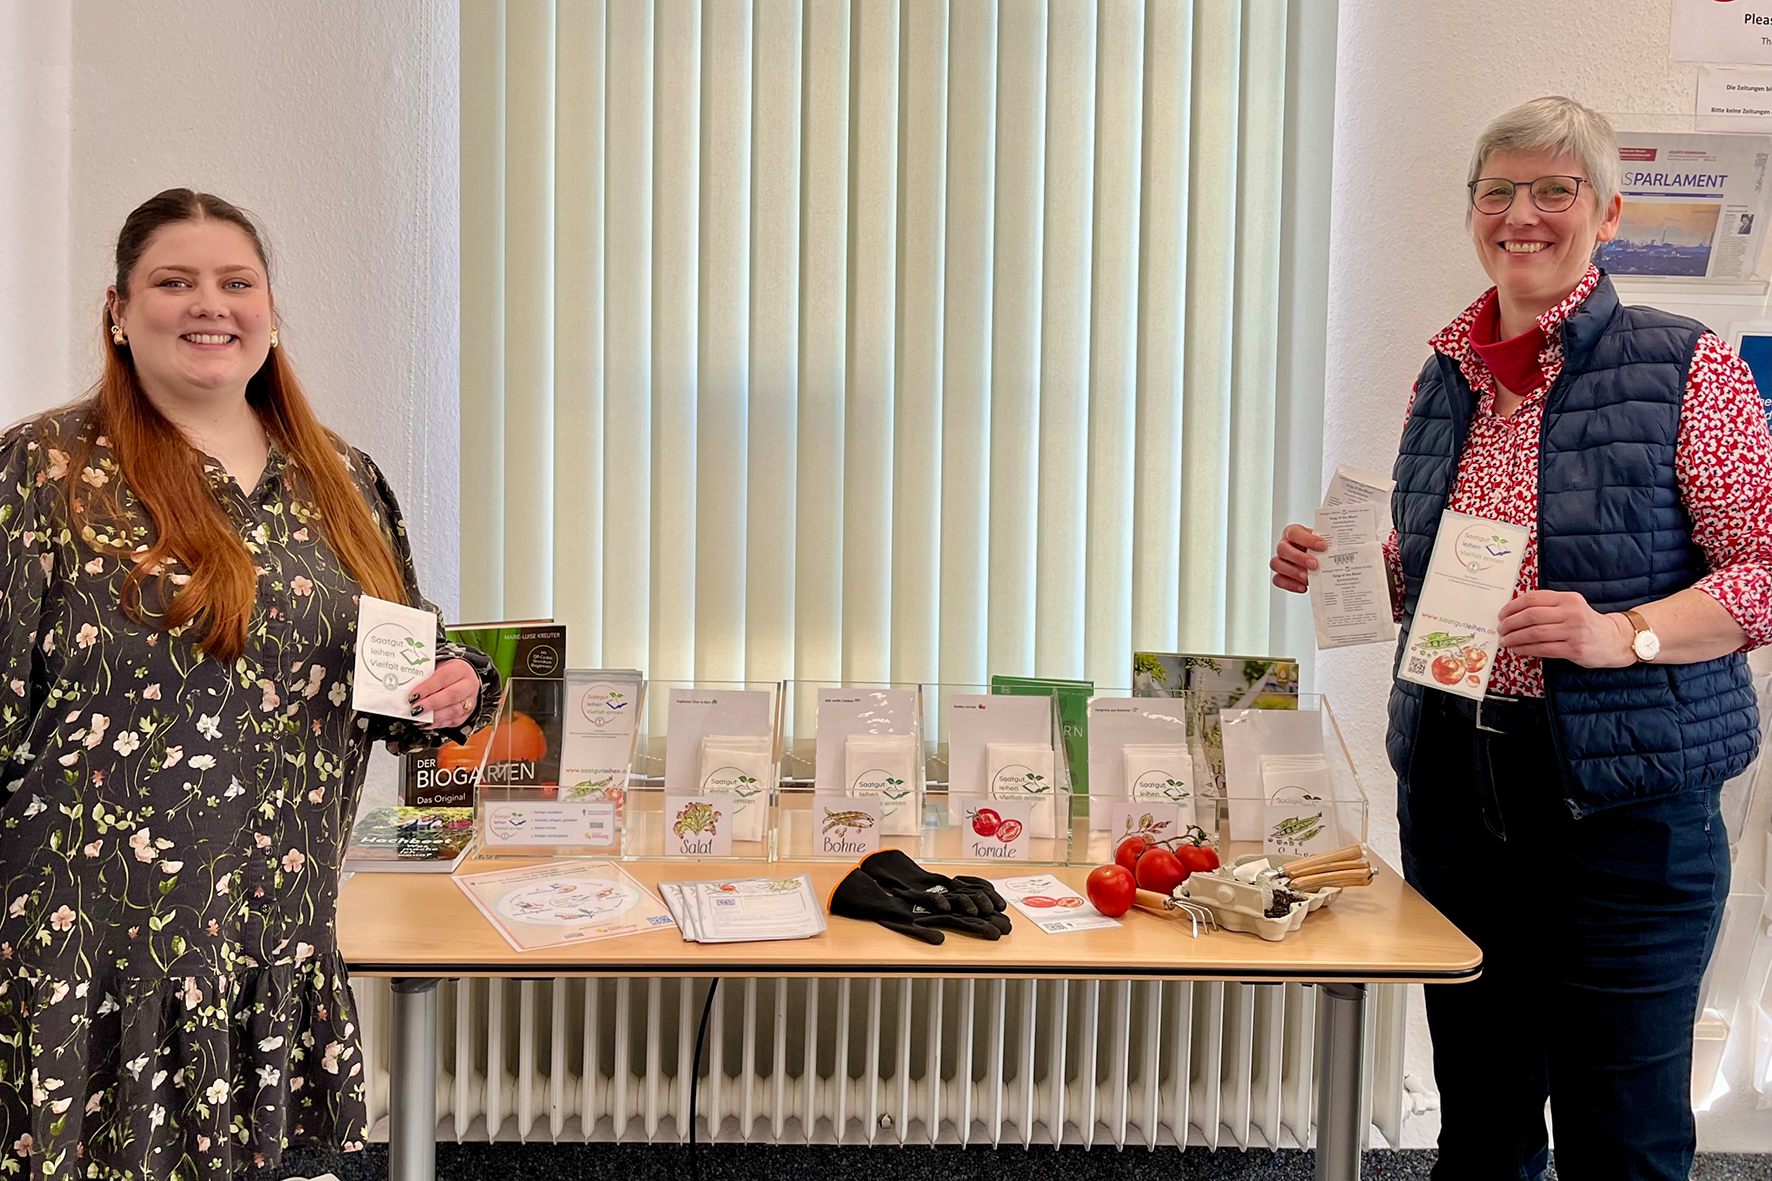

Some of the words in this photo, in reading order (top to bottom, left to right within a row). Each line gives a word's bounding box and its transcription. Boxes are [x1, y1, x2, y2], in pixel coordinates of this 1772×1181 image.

[1464, 532, 1490, 543] Saatgut
[1462, 541, 1481, 550] leihen
[1460, 550, 1482, 560] Vielfalt
[1483, 554, 1504, 564] ernten
[1421, 612, 1496, 636] www.saatgutleihen.de
[371, 635, 404, 647] Saatgut
[371, 647, 395, 658] leihen
[370, 659, 399, 671] Vielfalt
[400, 666, 424, 676] ernten
[417, 758, 435, 769] DER
[416, 762, 535, 788] BIOGARTEN
[417, 795, 432, 804] Das
[434, 792, 466, 805] Original
[680, 839, 712, 854] Salat
[823, 836, 866, 853] Bohne
[972, 842, 1017, 859] Tomate
